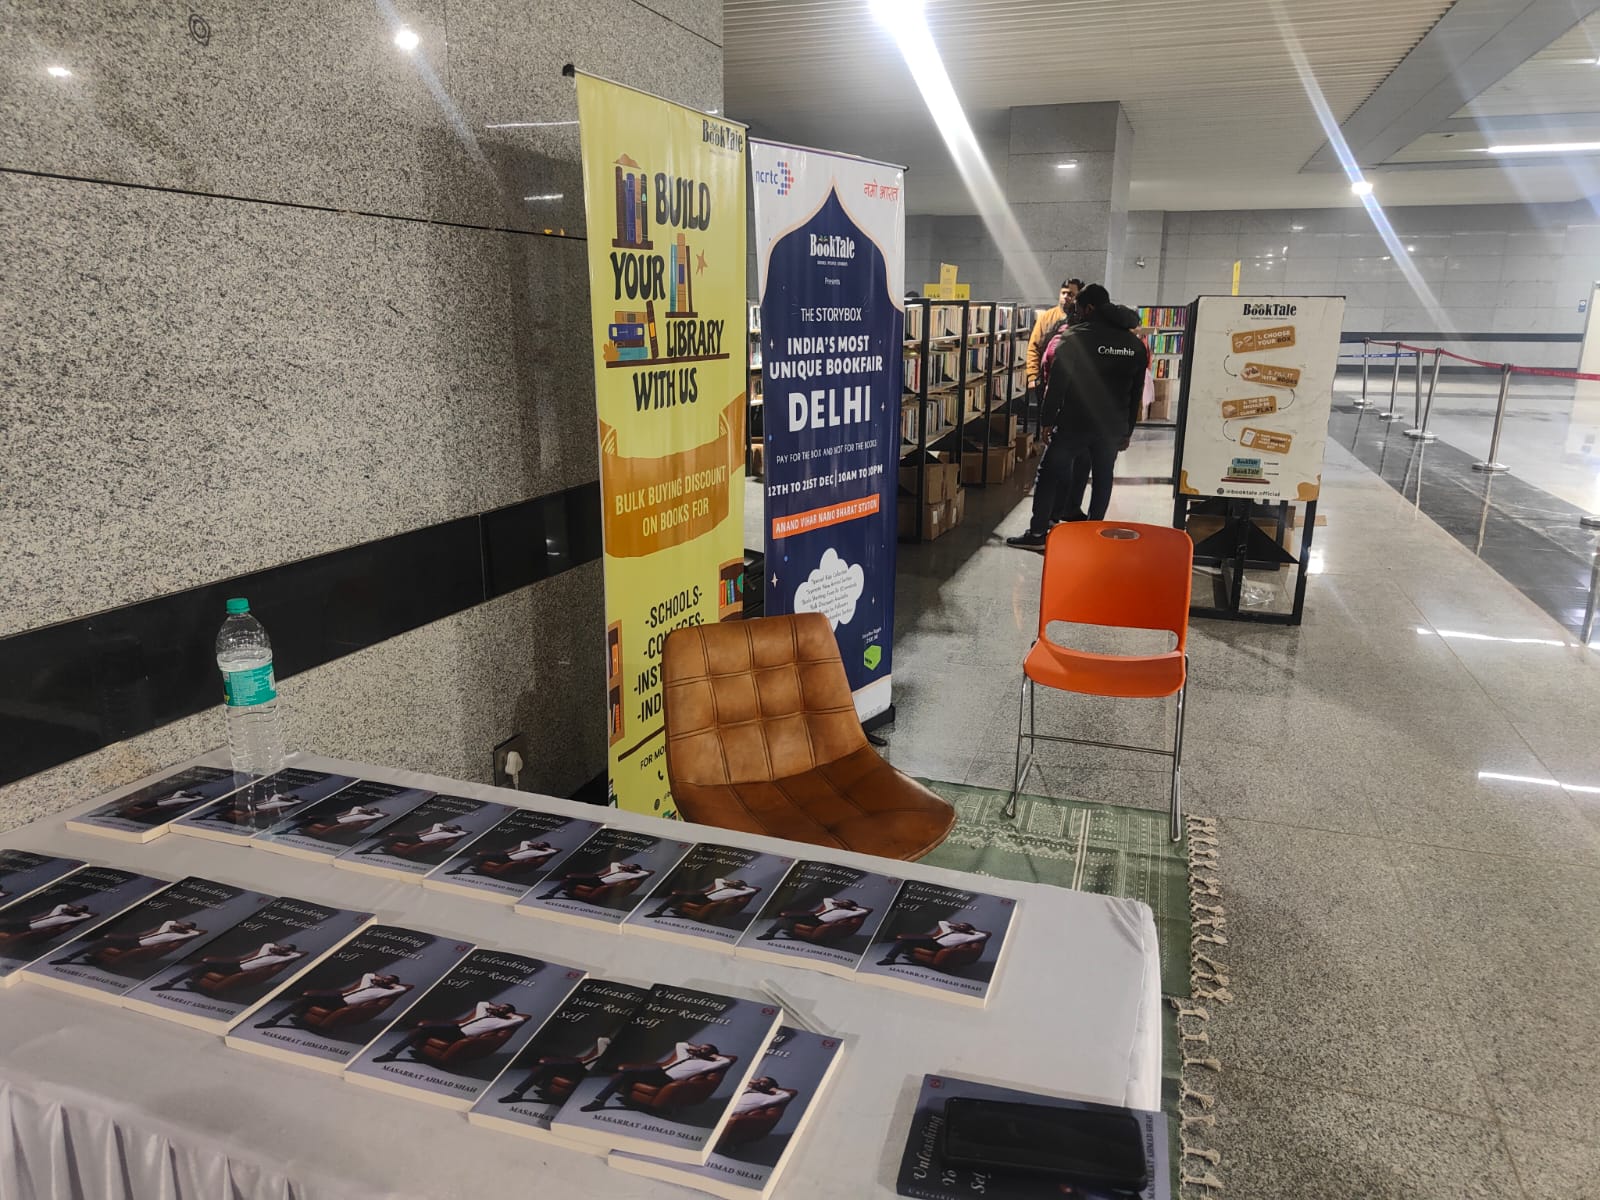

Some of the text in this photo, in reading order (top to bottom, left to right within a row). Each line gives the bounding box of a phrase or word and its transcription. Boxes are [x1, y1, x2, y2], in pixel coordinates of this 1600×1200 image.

[755, 168, 779, 185] ncrtc
[654, 172, 711, 232] BUILD
[809, 233, 856, 259] BookTale
[610, 252, 666, 301] YOUR
[800, 307, 862, 322] THE STORYBOX
[1243, 303, 1297, 316] BookTale
[665, 320, 725, 359] LIBRARY
[838, 334, 871, 354] MOST
[1257, 338, 1277, 346] YOUR
[1263, 330, 1291, 339] CHOOSE
[1097, 345, 1135, 356] Columbia
[769, 354, 884, 381] UNIQUE BOOKFAIR
[633, 368, 698, 412] WITH US
[787, 384, 872, 433] DELHI
[776, 455, 789, 464] PAY
[789, 452, 801, 463] FOR
[844, 443, 855, 452] FOR
[855, 441, 864, 450] THE
[615, 465, 727, 516] BULK BUYING DISCOUNT
[768, 483, 789, 497] 12TH
[790, 481, 801, 492] TO
[858, 467, 867, 479] TO
[642, 497, 709, 537] ON BOOKS FOR
[775, 519, 800, 534] ANAND
[645, 585, 703, 628] -SCHOOLS-
[640, 746, 665, 770] FOR MO
[801, 863, 860, 880] Unleashing
[901, 893, 980, 912] Your Radiant
[907, 883, 972, 902] Unleashing
[364, 928, 427, 948] Unleashing
[472, 953, 536, 975] Unleashing
[443, 976, 475, 990] Self
[457, 964, 537, 989] Your Radiant
[582, 983, 646, 1004] Unleashin
[654, 988, 728, 1012] Unleashing
[556, 1010, 592, 1023] Self
[571, 997, 634, 1018] Your Radi
[644, 1001, 733, 1026] Your Radiant
[630, 1016, 667, 1030] Self
[381, 1063, 425, 1082] MASARRAT
[422, 1074, 454, 1089] AHMAD
[592, 1113, 704, 1143] MASARRAT AHMAD SHAH
[911, 1114, 945, 1181] Unleashing
[705, 1160, 764, 1182] HMAD SHAH
[940, 1168, 958, 1187] Yo
